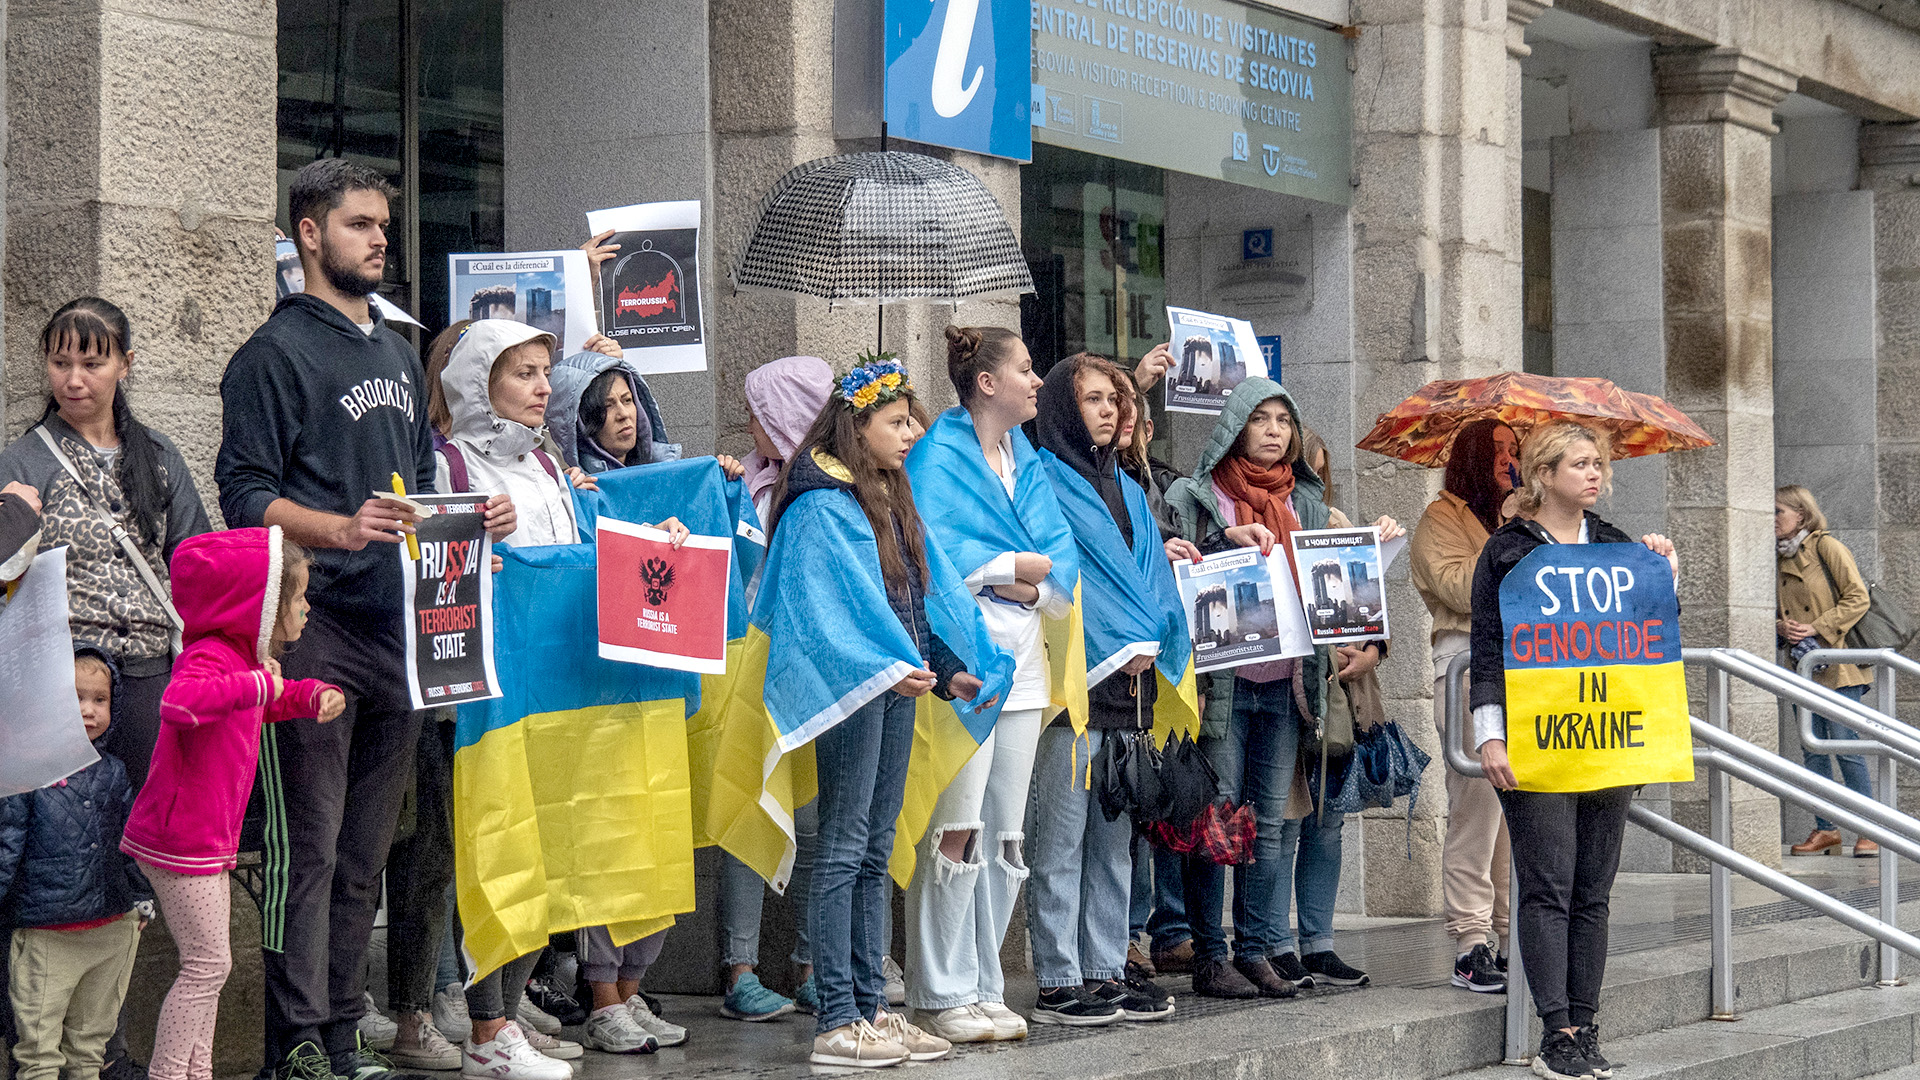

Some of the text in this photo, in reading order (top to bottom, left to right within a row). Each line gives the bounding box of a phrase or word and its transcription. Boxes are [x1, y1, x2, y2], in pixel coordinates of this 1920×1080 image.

[1031, 1, 1315, 102] ENTRAL DE RESERVAS DE SEGOVIA
[1202, 13, 1223, 43] DE
[1228, 19, 1317, 68] VISITANTES
[1031, 47, 1301, 132] EGOVIA VISITOR RECEPTION & BOOKING CENTRE
[472, 262, 494, 271] ¿Cuál
[505, 262, 511, 270] la
[513, 260, 549, 270] diferencia?
[620, 297, 668, 307] TERRORUSSIA
[607, 329, 629, 337] CLOSE
[672, 325, 695, 333] OPEN
[1310, 538, 1330, 546] ЧОМУ
[1331, 536, 1363, 545] РІЗНИЦЯ?
[420, 539, 480, 582] RUSSIA
[436, 580, 457, 606] IS A
[1535, 566, 1635, 616] STOP
[419, 604, 478, 634] TERRORIST
[637, 617, 678, 634] TERRORIST STATE
[659, 611, 664, 621] IS
[665, 612, 670, 622] A
[433, 633, 467, 660] STATE
[1511, 619, 1664, 662] GENOCIDE
[1579, 672, 1607, 702] IN
[1535, 711, 1645, 750] UKRAINE
